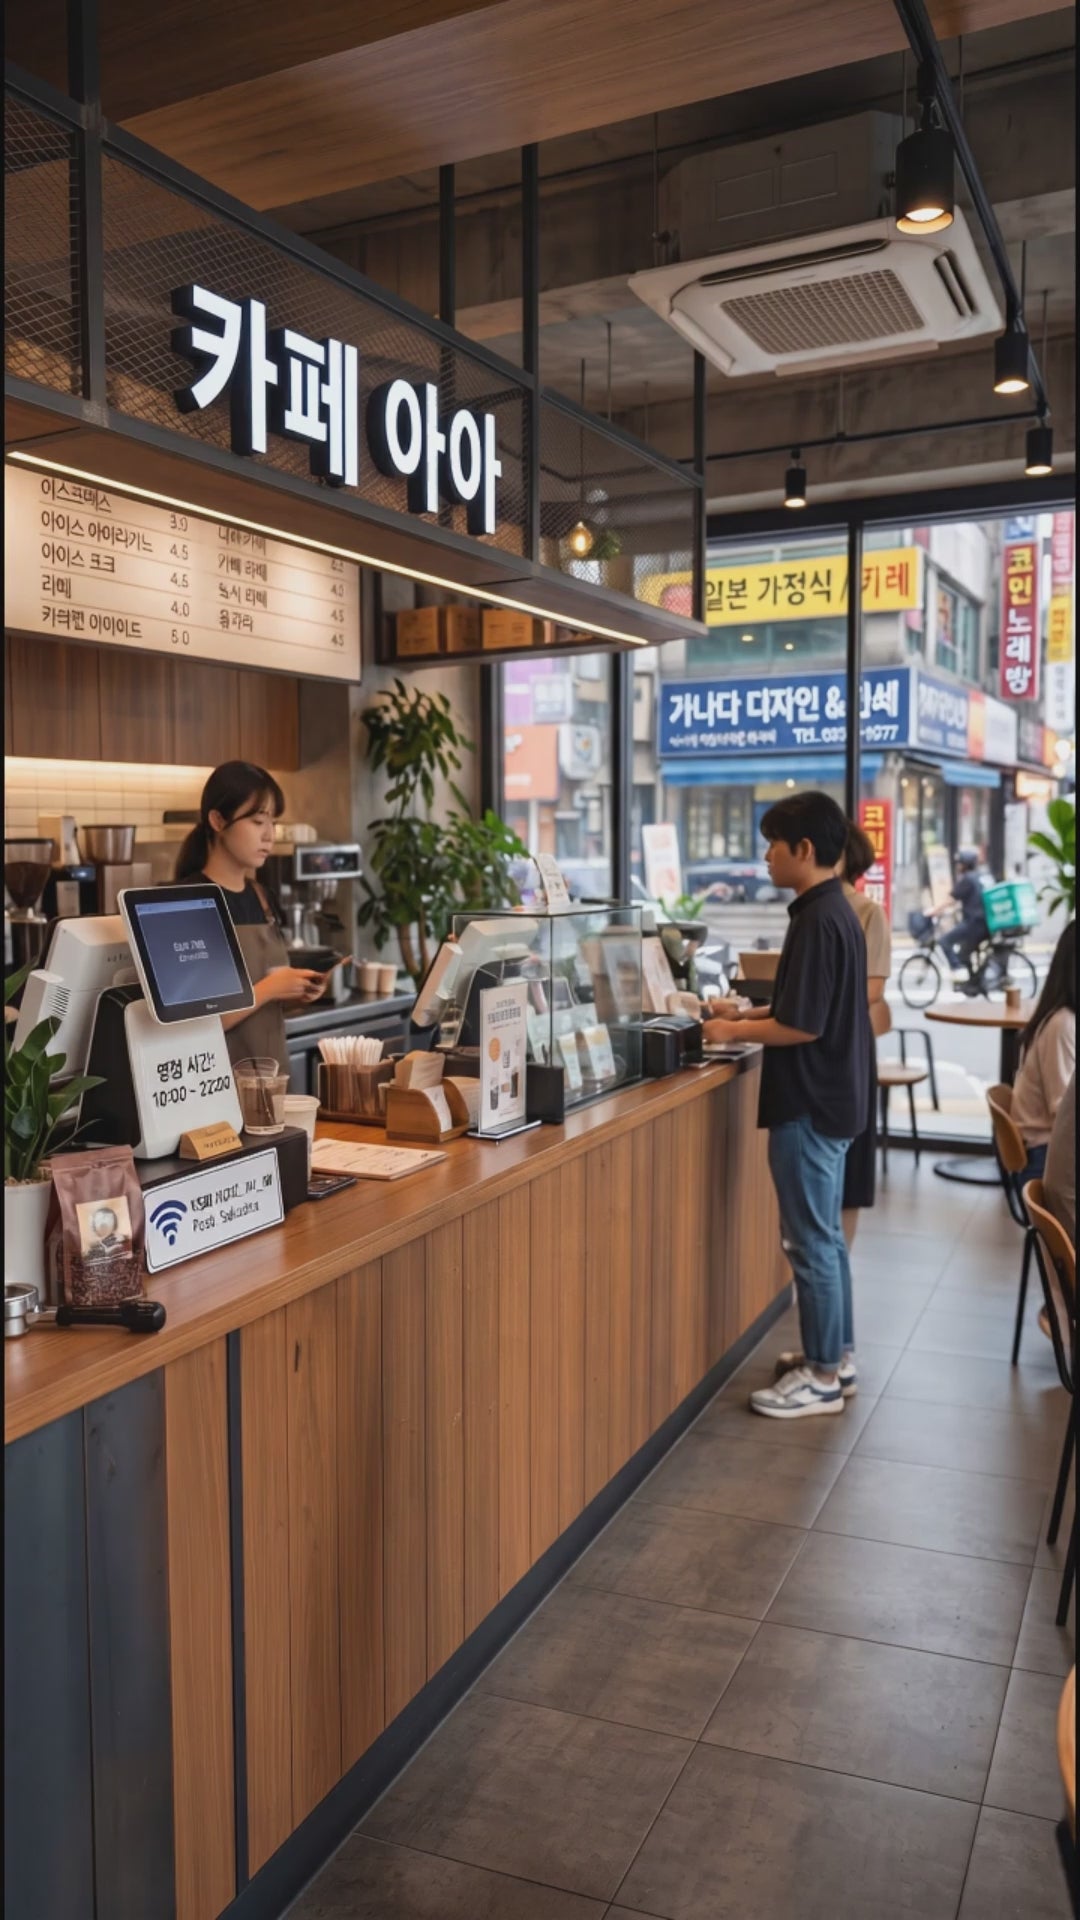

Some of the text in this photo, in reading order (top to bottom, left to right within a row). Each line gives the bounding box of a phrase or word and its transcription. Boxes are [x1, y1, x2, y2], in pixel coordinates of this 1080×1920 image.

[188, 284, 502, 535] 카페 아아
[170, 543, 189, 560] 4.5
[170, 572, 190, 588] 4.5
[706, 577, 748, 612] 일본
[757, 569, 832, 606] 가정식
[170, 601, 190, 617] 4.0
[668, 689, 742, 728] 가나다
[746, 686, 820, 724] 디자인
[824, 685, 847, 720] &
[152, 1086, 187, 1107] 10:00
